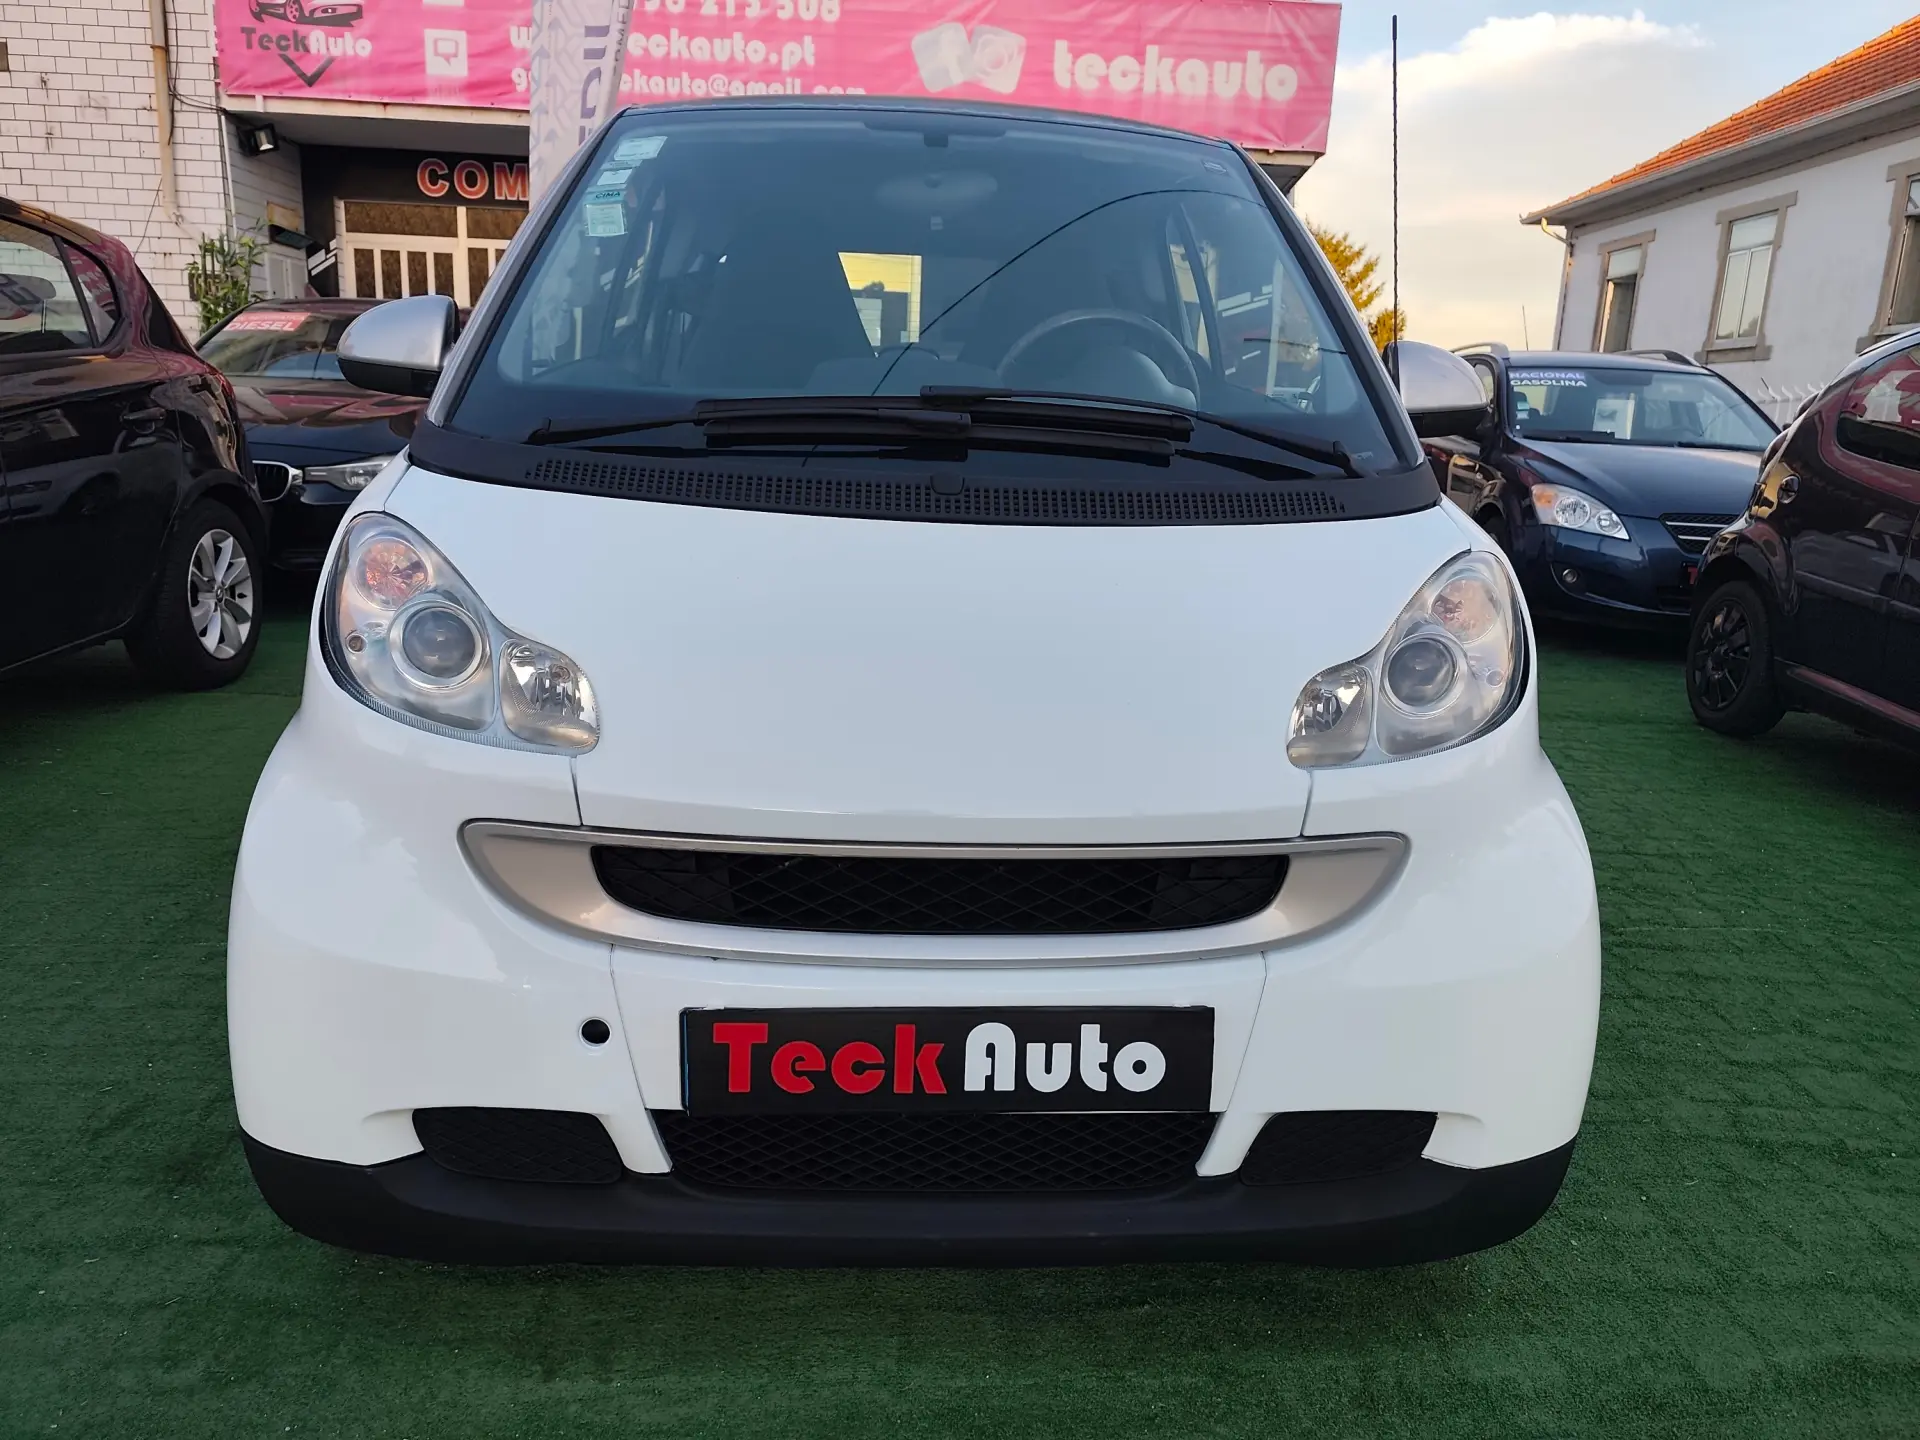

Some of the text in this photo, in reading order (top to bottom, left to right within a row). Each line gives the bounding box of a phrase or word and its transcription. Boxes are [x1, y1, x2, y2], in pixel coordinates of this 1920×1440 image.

[1053, 39, 1299, 102] teckauto
[223, 320, 296, 332] DIESEL
[1508, 371, 1585, 379] NACIONAL
[1510, 379, 1588, 388] GASOLINA
[712, 1022, 1167, 1094] Teck Auto
